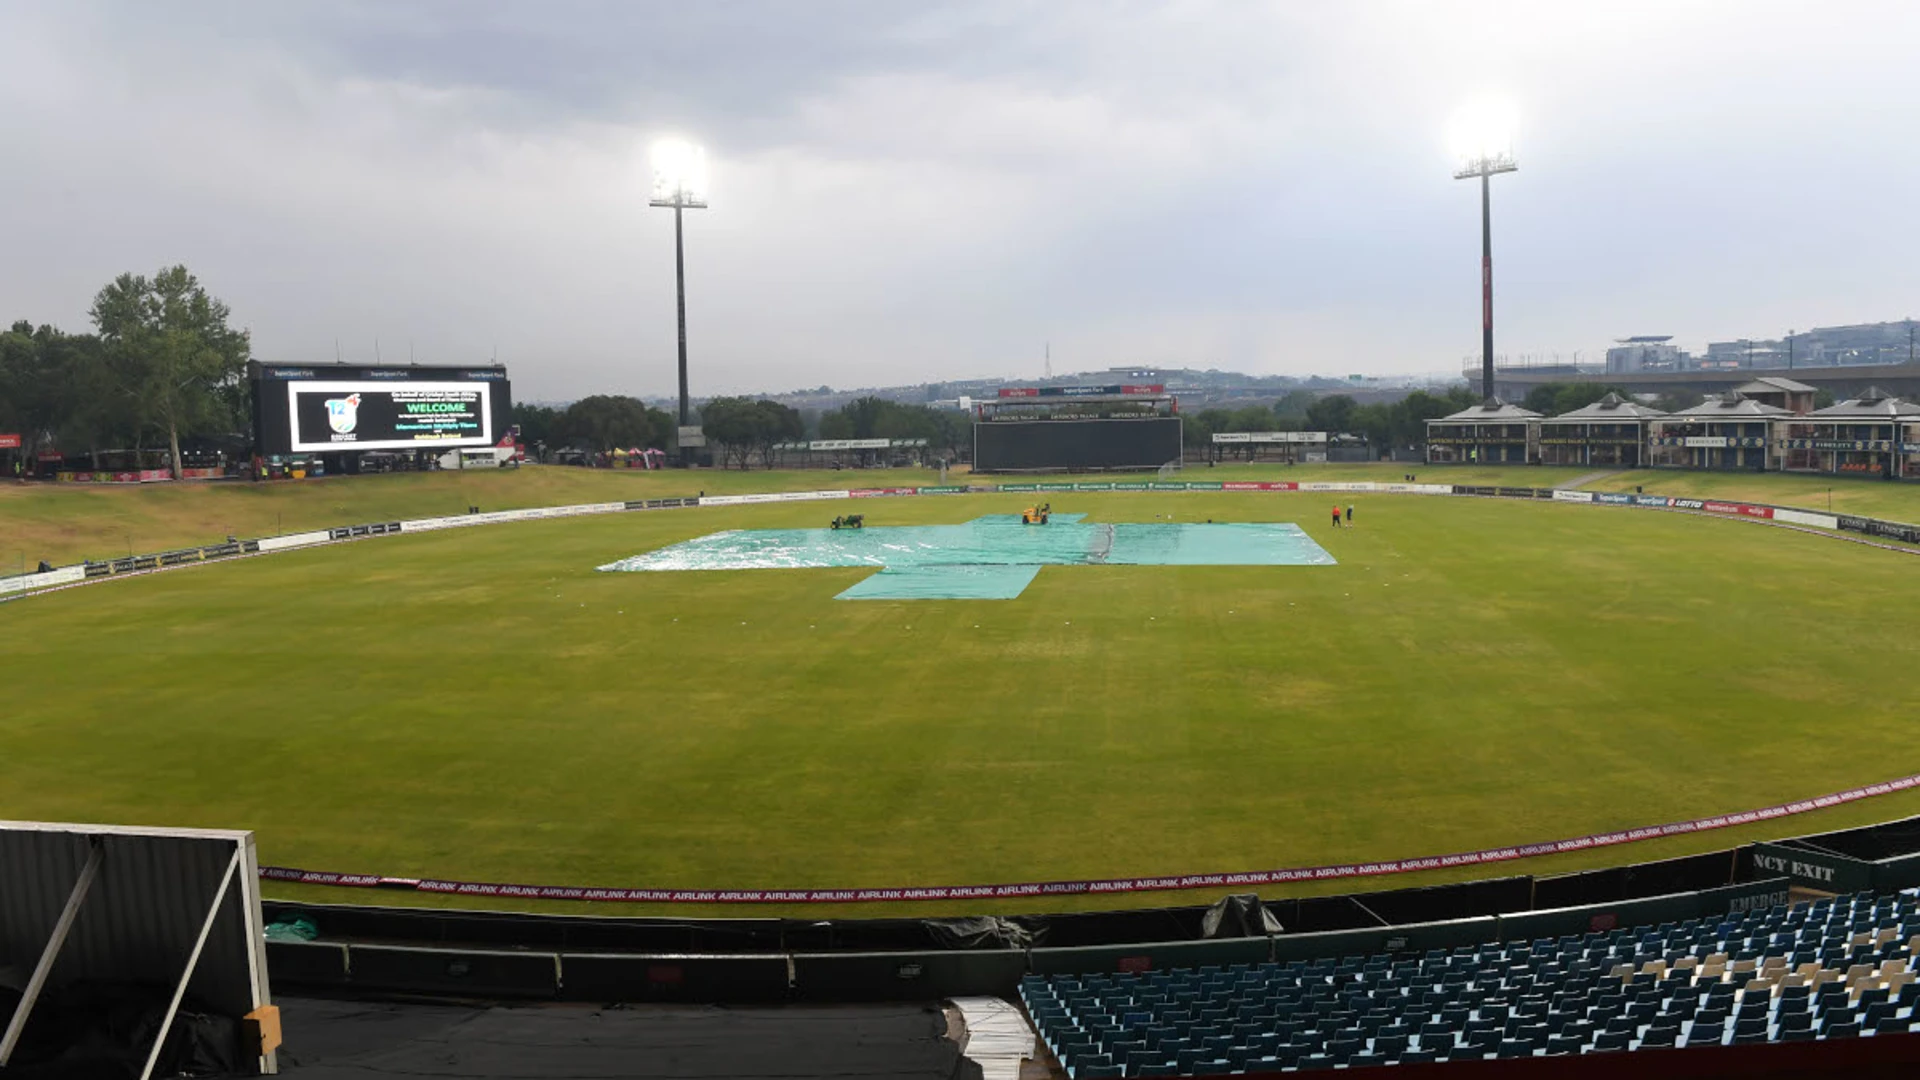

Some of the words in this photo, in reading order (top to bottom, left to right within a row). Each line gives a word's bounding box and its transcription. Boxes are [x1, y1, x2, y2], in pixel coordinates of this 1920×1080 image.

[406, 402, 466, 413] WELCOME
[1599, 494, 1628, 503] SuperSport
[1636, 496, 1667, 506] SuperSport
[1675, 499, 1704, 509] LOTTO
[302, 872, 338, 882] AIRLINK
[339, 875, 379, 884] AIRLINK
[420, 881, 457, 891] AIRLINK
[458, 884, 498, 894] AIRLINK
[500, 885, 540, 896] AIRLINK
[541, 887, 582, 897] AIRLINK
[585, 890, 626, 899] AIRLINK
[628, 891, 672, 899] AIRLINK
[673, 892, 716, 900] AIRLINK
[718, 892, 762, 900] AIRLINK
[764, 892, 808, 900] AIRLINK
[811, 891, 854, 899] AIRLINK
[857, 890, 902, 899] AIRLINK
[903, 888, 948, 899] AIRLINK
[950, 887, 993, 897] AIRLINK
[996, 885, 1041, 895] AIRLINK
[1042, 883, 1087, 893] AIRLINK
[1089, 881, 1133, 891] AIRLINK
[1136, 879, 1179, 888] AIRLINK
[1181, 876, 1224, 885] AIRLINK
[1226, 873, 1269, 883] AIRLINK
[1271, 870, 1313, 881] AIRLINK
[1316, 867, 1356, 877] AIRLINK
[1359, 864, 1399, 875] AIRLINK
[1401, 859, 1440, 870] AIRLINK
[1441, 854, 1481, 865] AIRLINK
[1481, 849, 1520, 860] AIRLINK
[1557, 838, 1594, 850] AIRLINK
[1594, 832, 1628, 844] AIRLINK
[1628, 826, 1663, 839] AIRLINK
[1696, 817, 1729, 829] AIRLINK
[1753, 853, 1787, 873] NCY
[1791, 861, 1835, 882] EXIT
